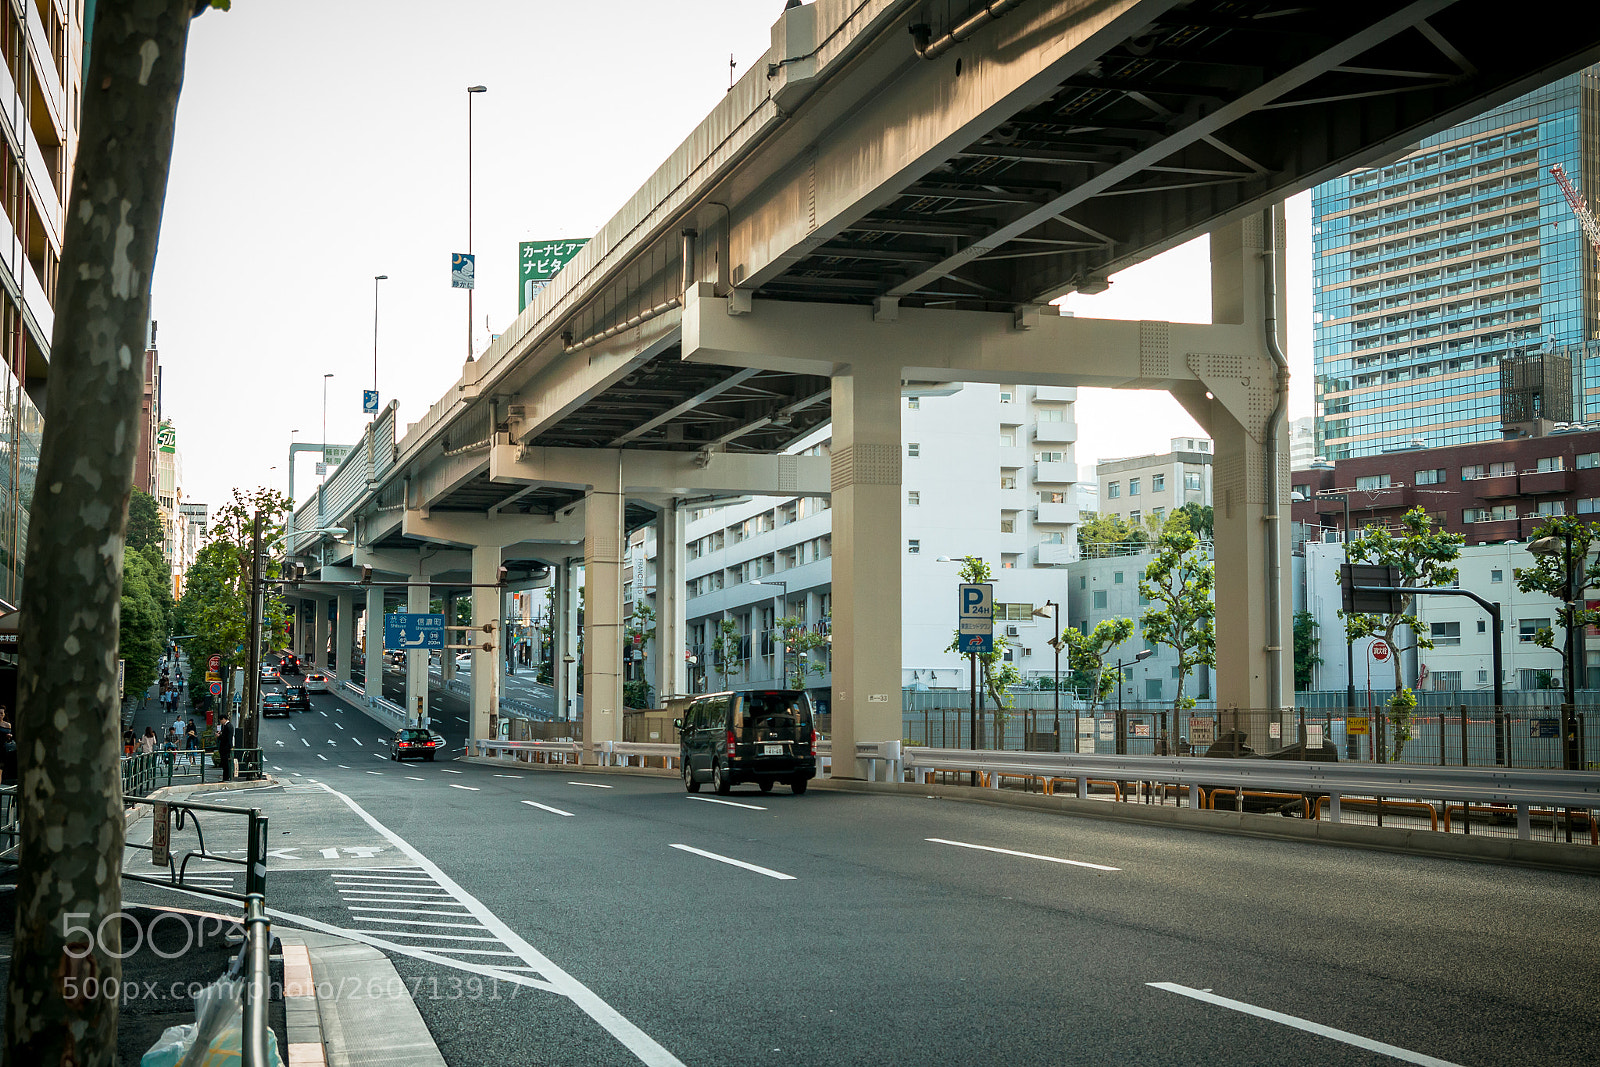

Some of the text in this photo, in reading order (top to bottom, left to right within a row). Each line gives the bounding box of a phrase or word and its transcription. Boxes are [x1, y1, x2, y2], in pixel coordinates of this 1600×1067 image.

[523, 258, 568, 275] ナビタ
[963, 588, 984, 614] P
[972, 605, 990, 614] 24H
[417, 618, 442, 626] 信濃町
